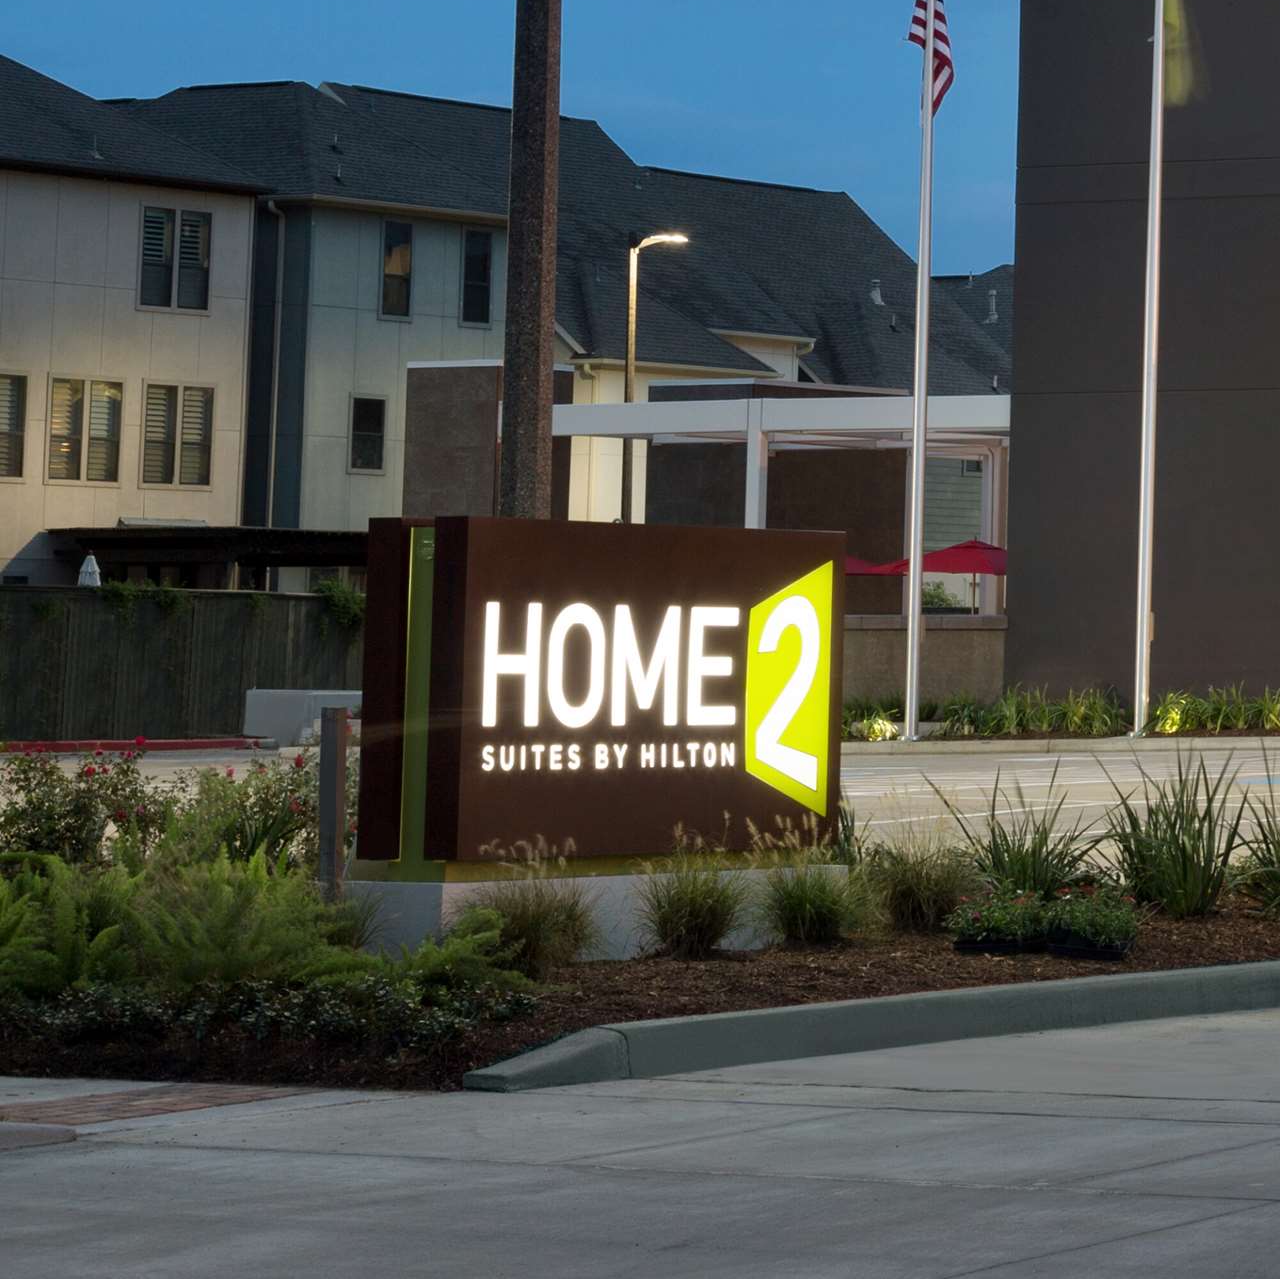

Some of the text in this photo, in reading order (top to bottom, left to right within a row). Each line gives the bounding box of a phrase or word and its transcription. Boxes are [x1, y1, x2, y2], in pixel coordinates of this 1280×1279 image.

[481, 742, 736, 772] SUITES BY HILTON
